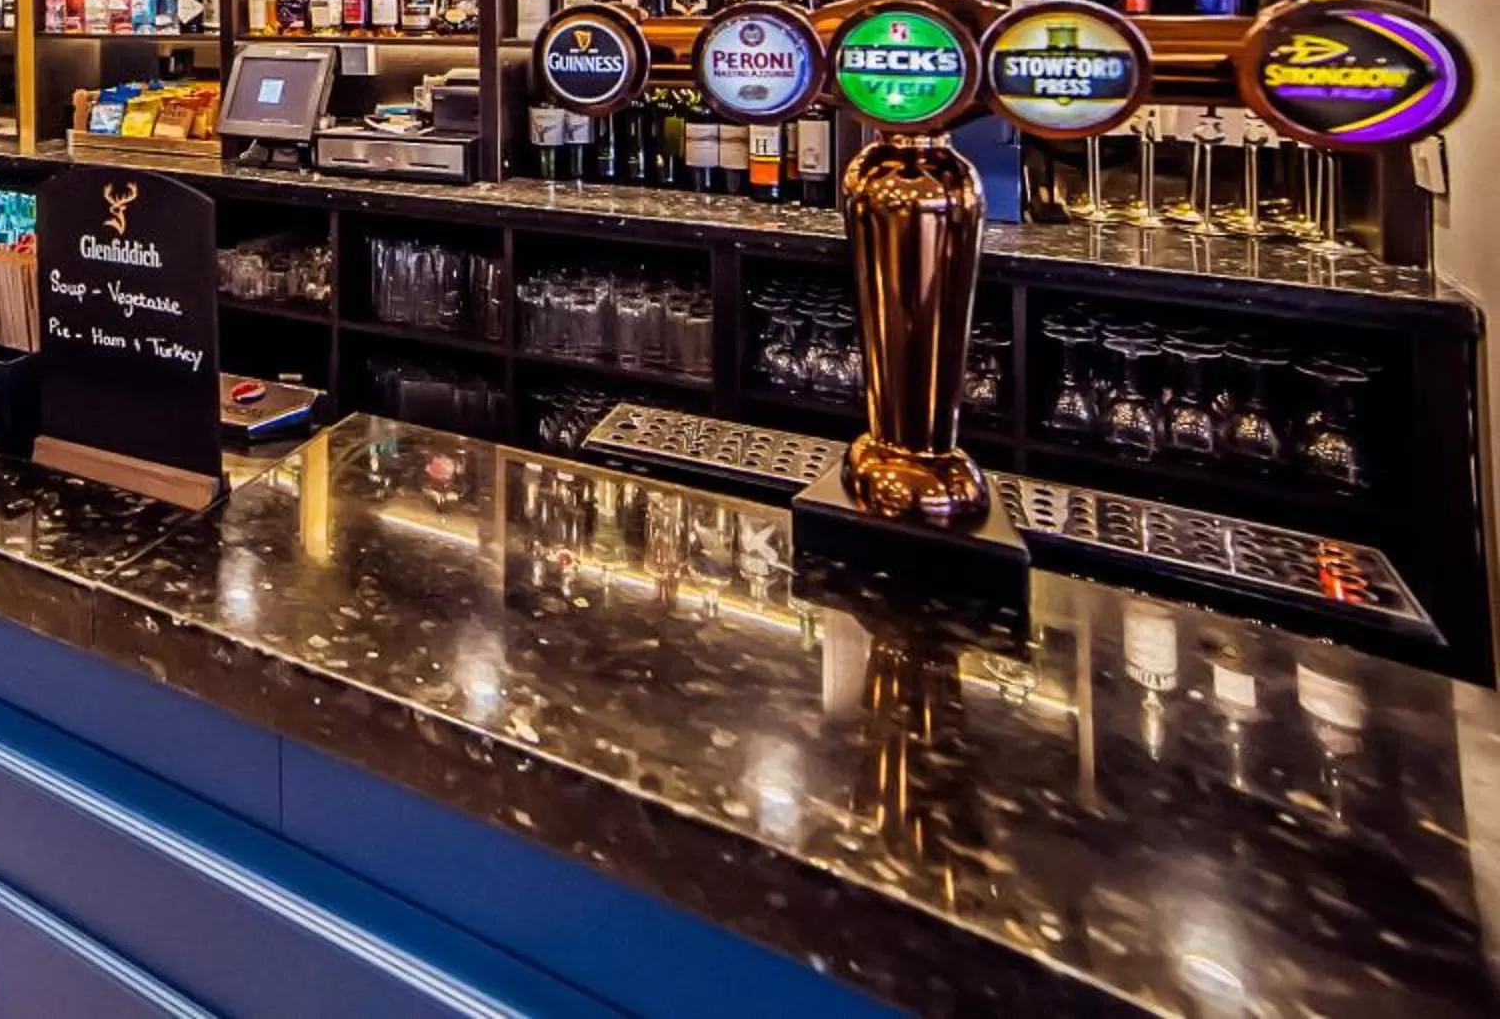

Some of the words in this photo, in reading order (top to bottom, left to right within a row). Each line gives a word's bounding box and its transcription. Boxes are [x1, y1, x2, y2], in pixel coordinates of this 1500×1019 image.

[548, 52, 623, 73] GUINNESS
[713, 50, 794, 70] PERONI
[843, 48, 958, 71] BECK'S
[1004, 57, 1124, 78] STOWFORD
[1034, 79, 1092, 95] PRESS
[80, 234, 162, 268] Glenfiddich
[50, 269, 87, 303] Soup
[107, 280, 183, 318] Vegetable
[49, 316, 71, 339] Pie
[91, 327, 126, 350] Ham
[145, 336, 205, 372] Turkey
